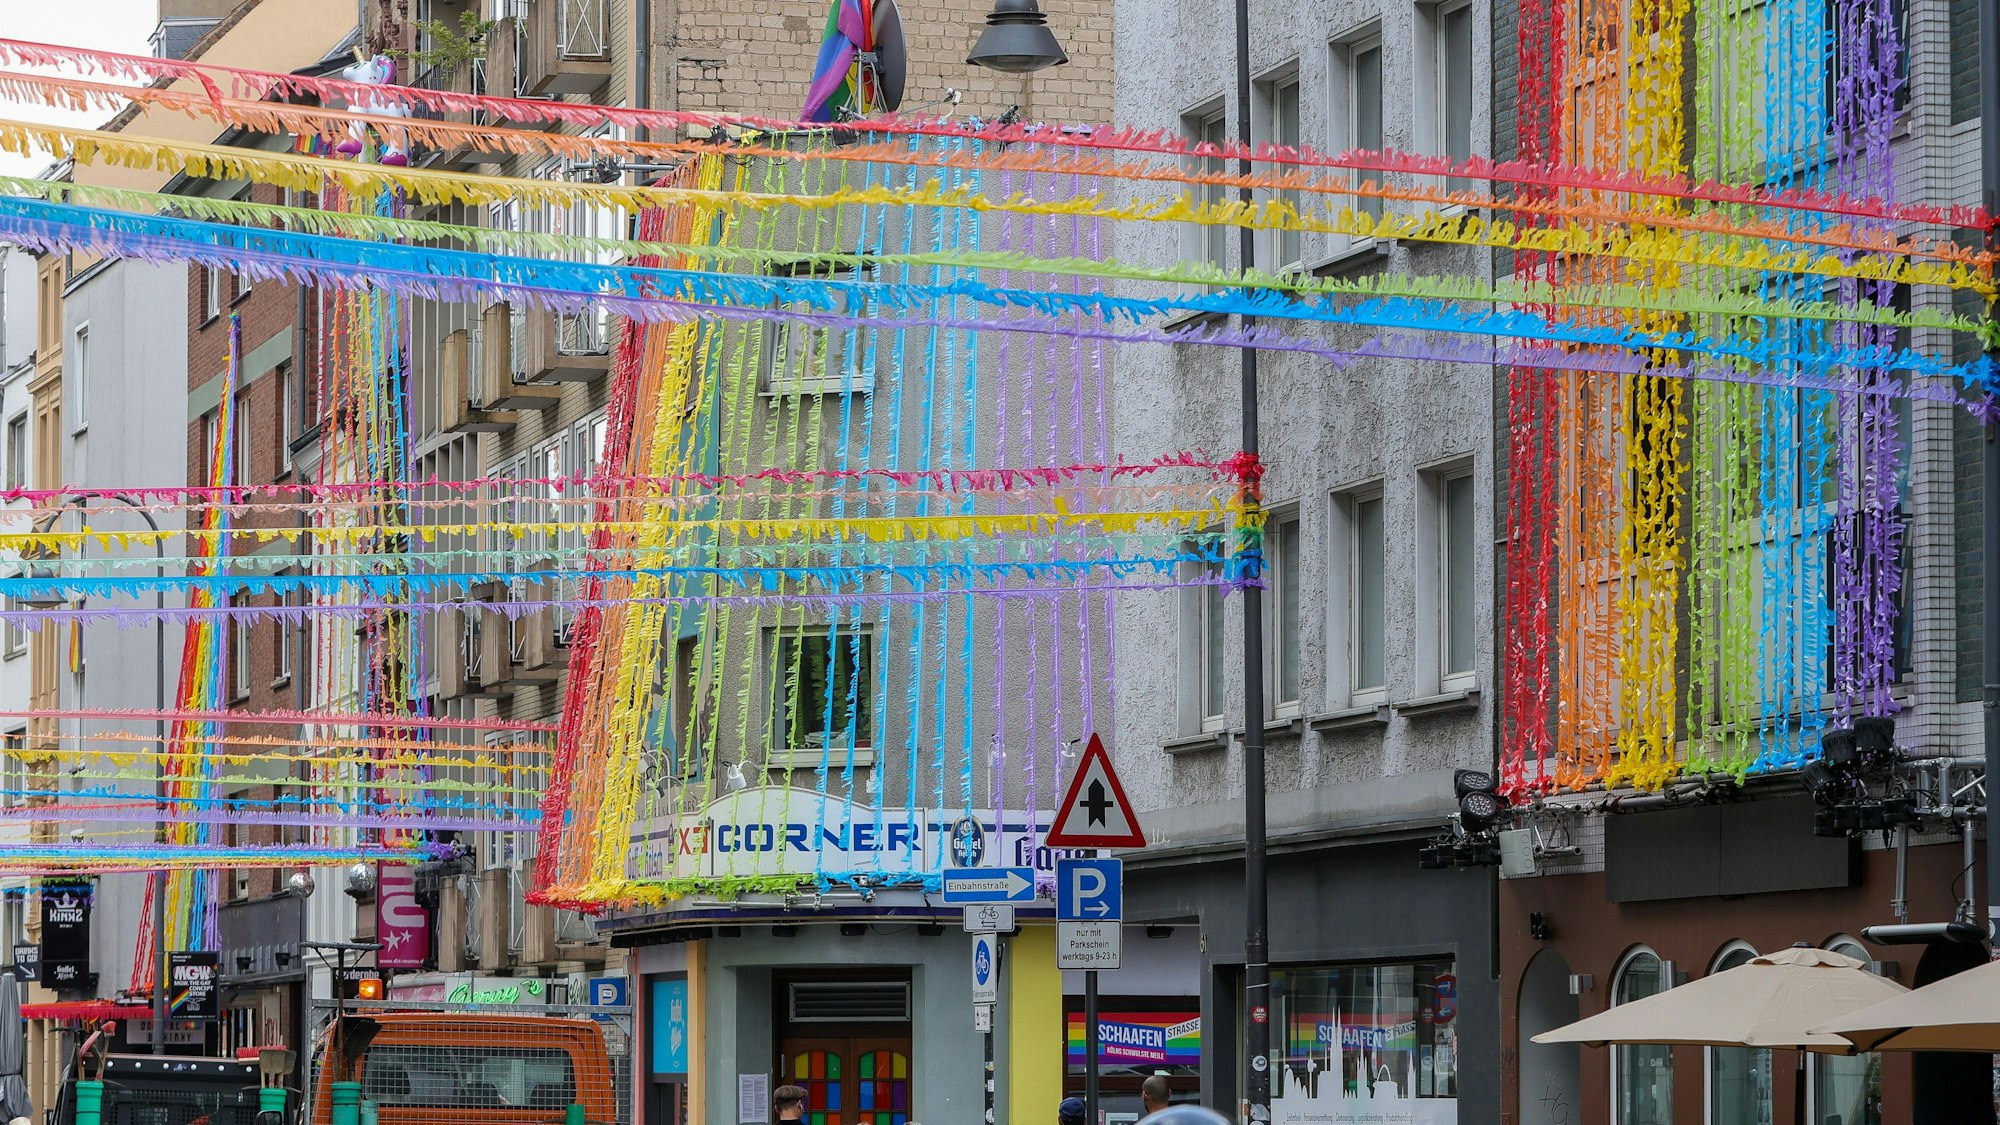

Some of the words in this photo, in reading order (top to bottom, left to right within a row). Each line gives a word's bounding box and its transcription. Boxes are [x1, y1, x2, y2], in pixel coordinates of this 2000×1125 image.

[718, 823, 922, 853] CORNER
[948, 881, 1010, 891] Einbahnstraße
[1072, 868, 1107, 918] P
[1076, 929, 1089, 937] nur
[1090, 928, 1102, 937] mit
[1070, 940, 1110, 949] Parkschein
[1199, 933, 1207, 953] 61
[15, 946, 38, 955] DRINKS
[1062, 952, 1094, 962] werktags
[1095, 951, 1111, 960] 9-23
[1112, 951, 1117, 960] h
[16, 955, 26, 963] TO
[27, 954, 38, 962] GO!
[1098, 1023, 1163, 1048] SCHAAFEN
[1167, 1019, 1199, 1038] STRASSE
[1318, 1024, 1383, 1048] SCAAFEN
[1106, 1046, 1122, 1056] KÖLNS
[1122, 1048, 1150, 1059] SCHWULSTE
[1150, 1051, 1164, 1060] MEILE
